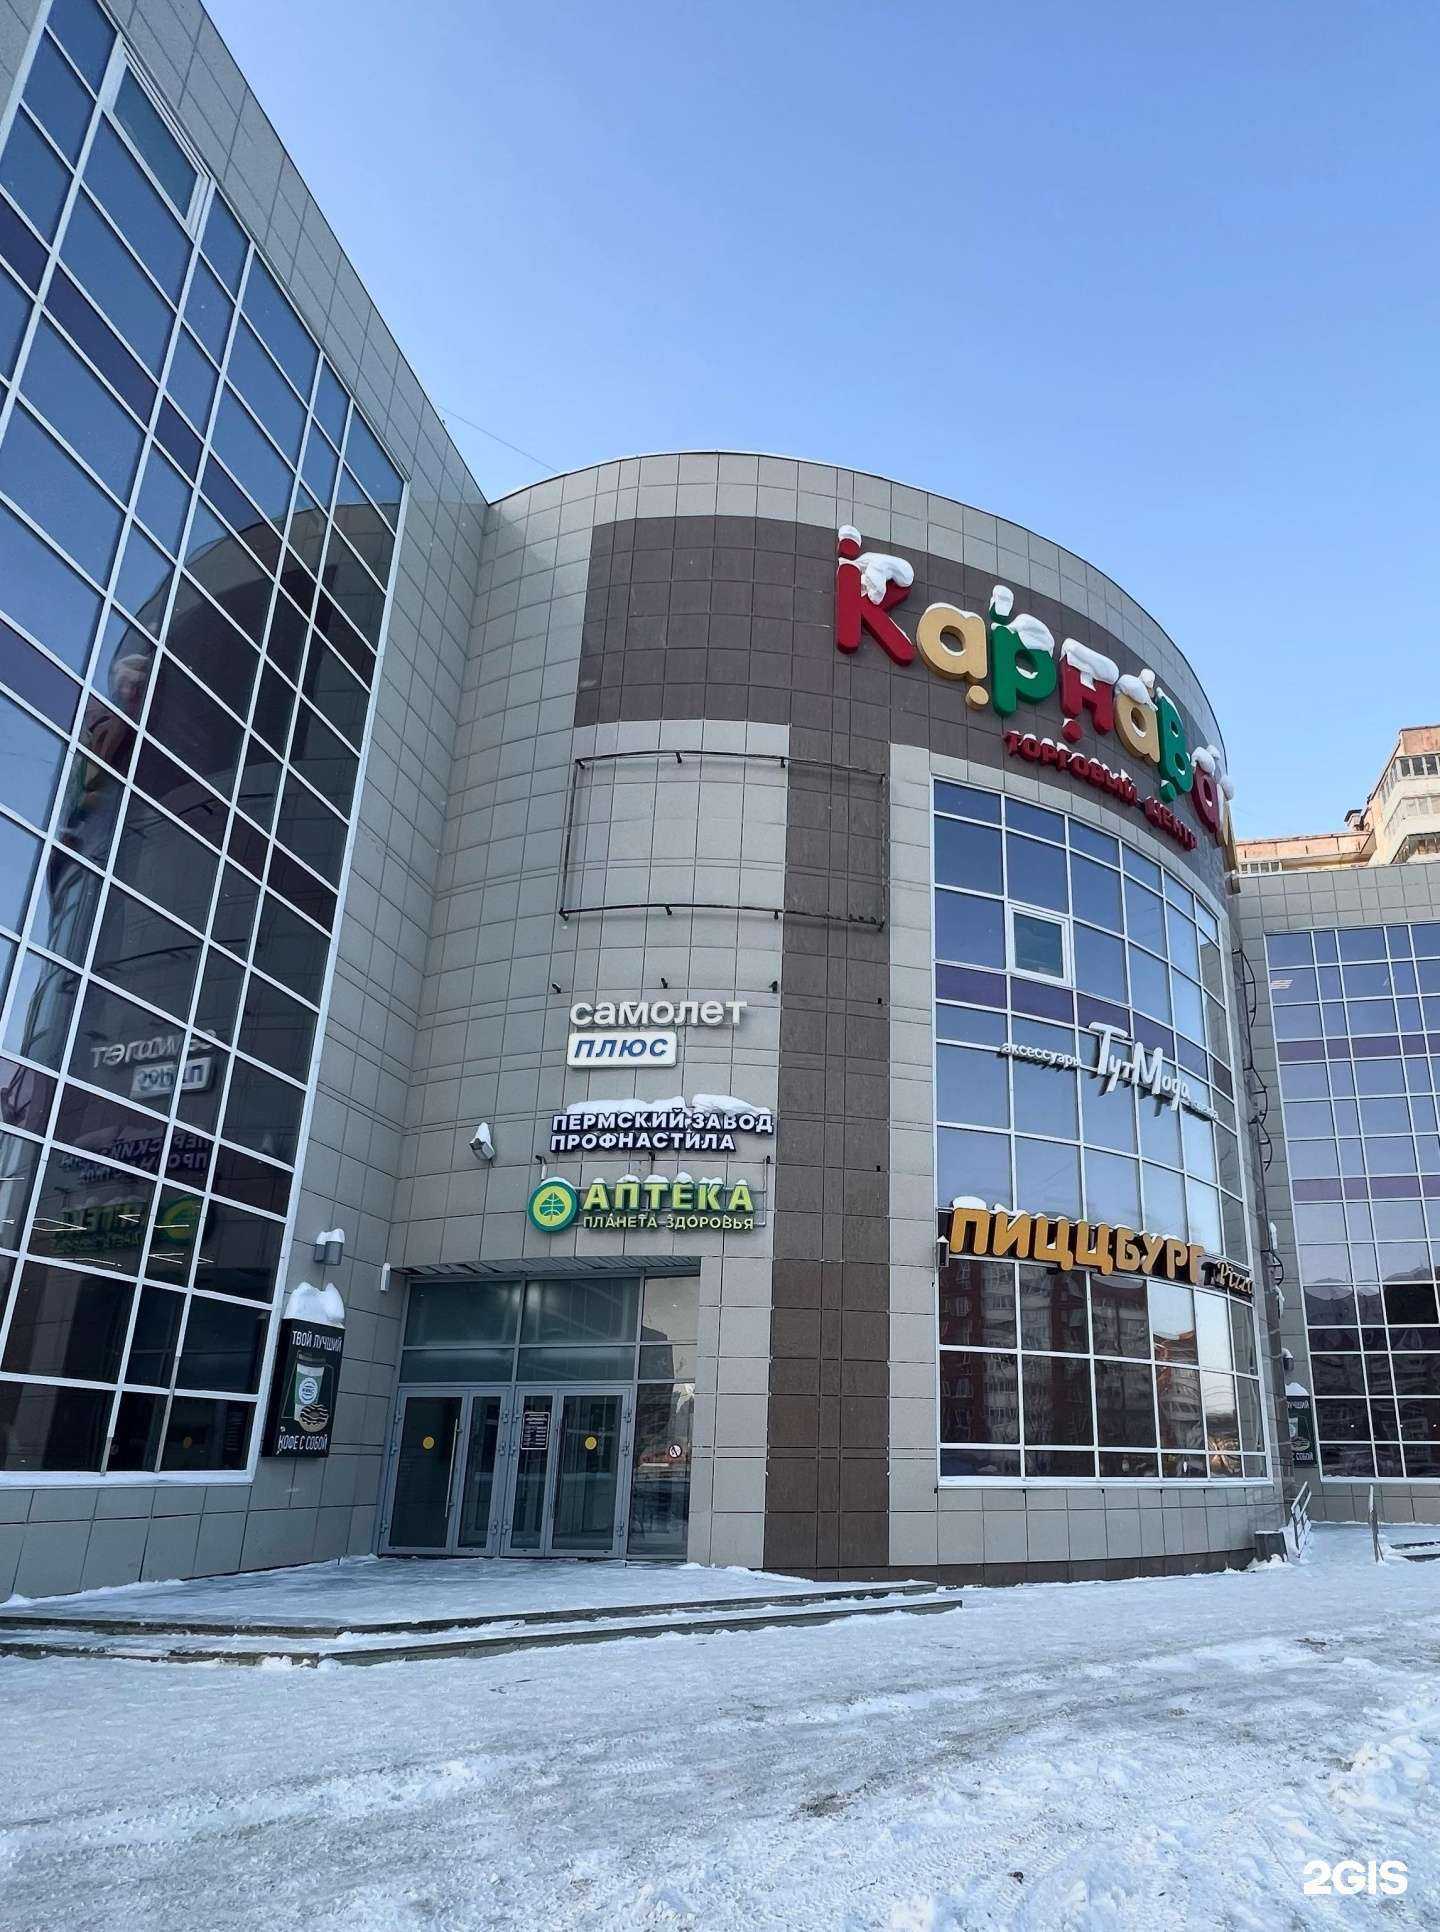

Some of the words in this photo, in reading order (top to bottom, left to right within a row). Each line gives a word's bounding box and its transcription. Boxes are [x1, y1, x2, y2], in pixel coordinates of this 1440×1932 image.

[570, 1000, 747, 1026] самолет
[552, 1108, 686, 1132] ПЕРМСКИЙ
[691, 1113, 774, 1134] ЗАВОД
[550, 1132, 736, 1152] ПРОФНАСТИЛА
[582, 1180, 755, 1213] АПТЕКА
[583, 1214, 658, 1230] ПЛАНЕТА
[666, 1214, 755, 1231] ЗДОРОВЬЯ
[949, 1206, 1206, 1284] ПИЦЦБУРГ
[292, 1330, 313, 1348] ТВОЙ
[313, 1333, 343, 1353] ЛУЧШИЙ
[278, 1434, 300, 1450] КОФЕ
